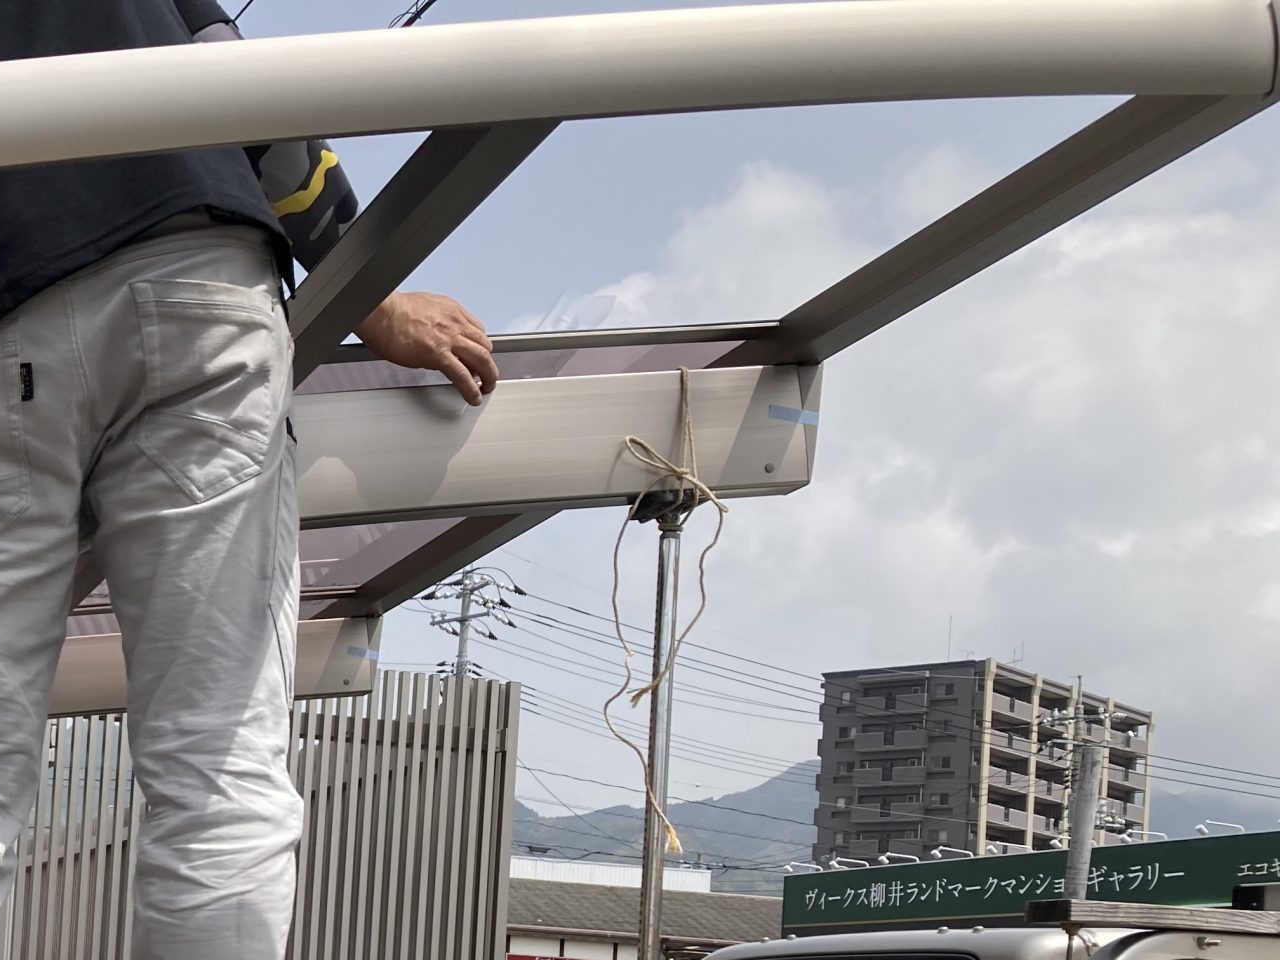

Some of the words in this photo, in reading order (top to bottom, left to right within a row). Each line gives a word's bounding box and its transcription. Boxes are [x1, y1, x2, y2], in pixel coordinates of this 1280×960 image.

[805, 863, 1185, 911] ヴィークス柳井ランドマークマンショギャラリー
